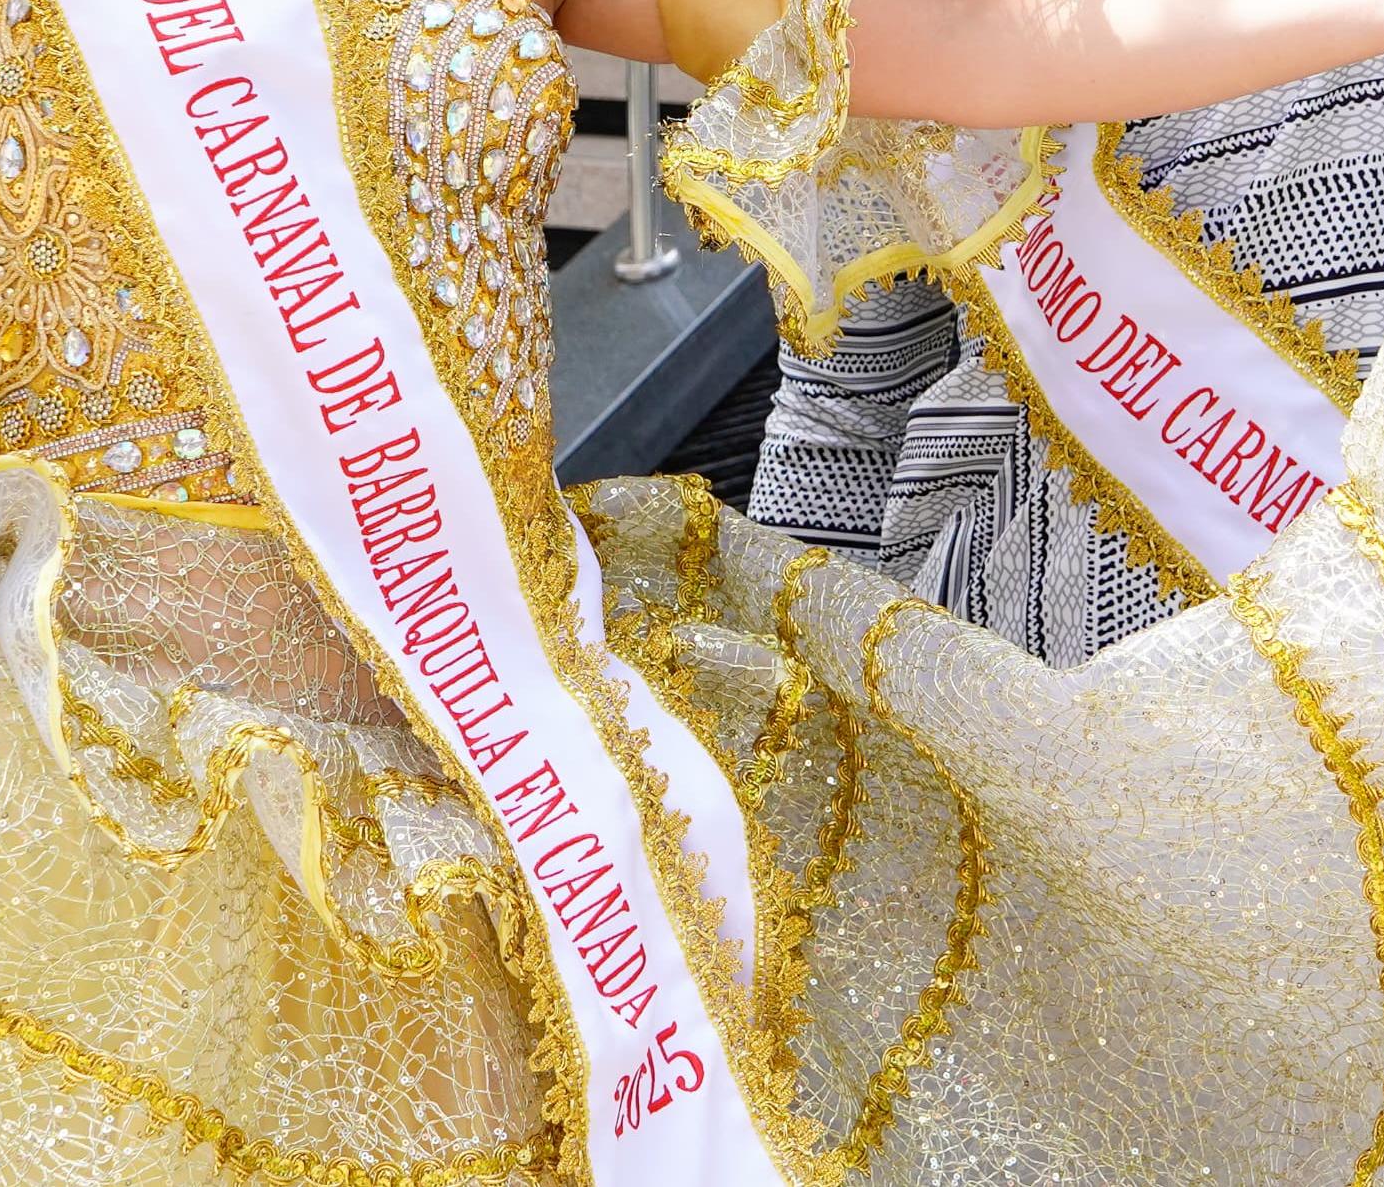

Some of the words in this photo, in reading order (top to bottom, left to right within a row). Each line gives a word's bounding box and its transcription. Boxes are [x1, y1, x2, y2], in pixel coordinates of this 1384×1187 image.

[185, 76, 360, 354] CARNAVAL
[306, 337, 403, 435] DE
[1015, 209, 1103, 344] MOMO
[1075, 314, 1182, 421] DEL
[338, 426, 529, 774] BARRANQUILLA
[494, 759, 579, 843] EN
[533, 833, 658, 1028] CANADA
[614, 1021, 705, 1140] 2025
